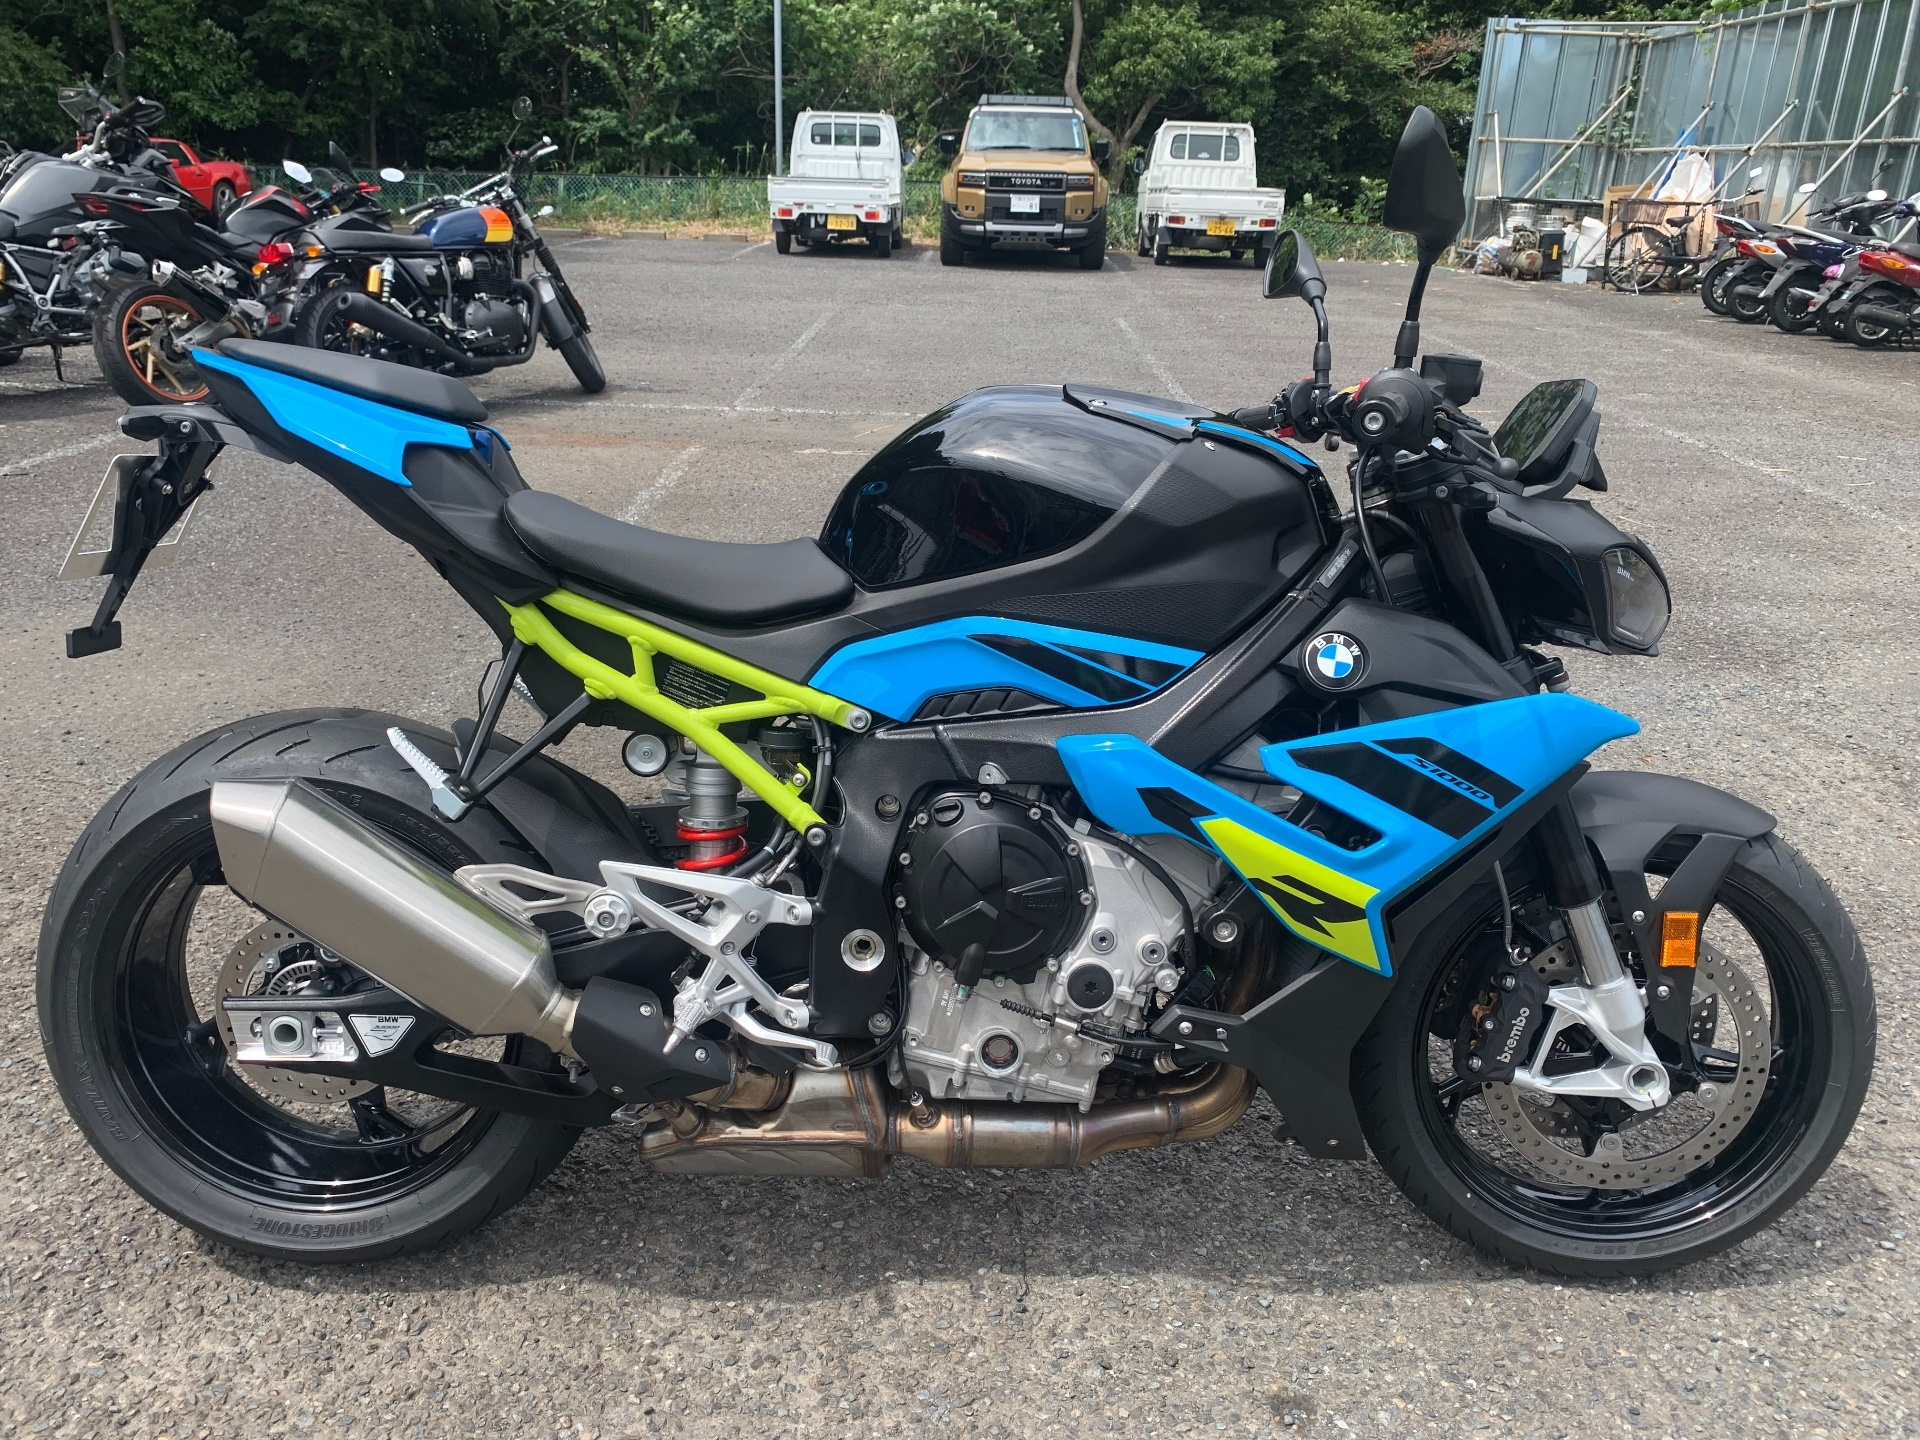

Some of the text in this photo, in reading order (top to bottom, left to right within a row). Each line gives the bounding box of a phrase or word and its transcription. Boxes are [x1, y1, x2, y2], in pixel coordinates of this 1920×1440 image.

[1314, 634, 1362, 657] BMW
[1406, 756, 1491, 800] S1000
[1496, 1007, 1530, 1063] brembo
[1742, 1158, 1800, 1214] BATTLAX
[251, 1215, 384, 1240] BRIDGESTONE
